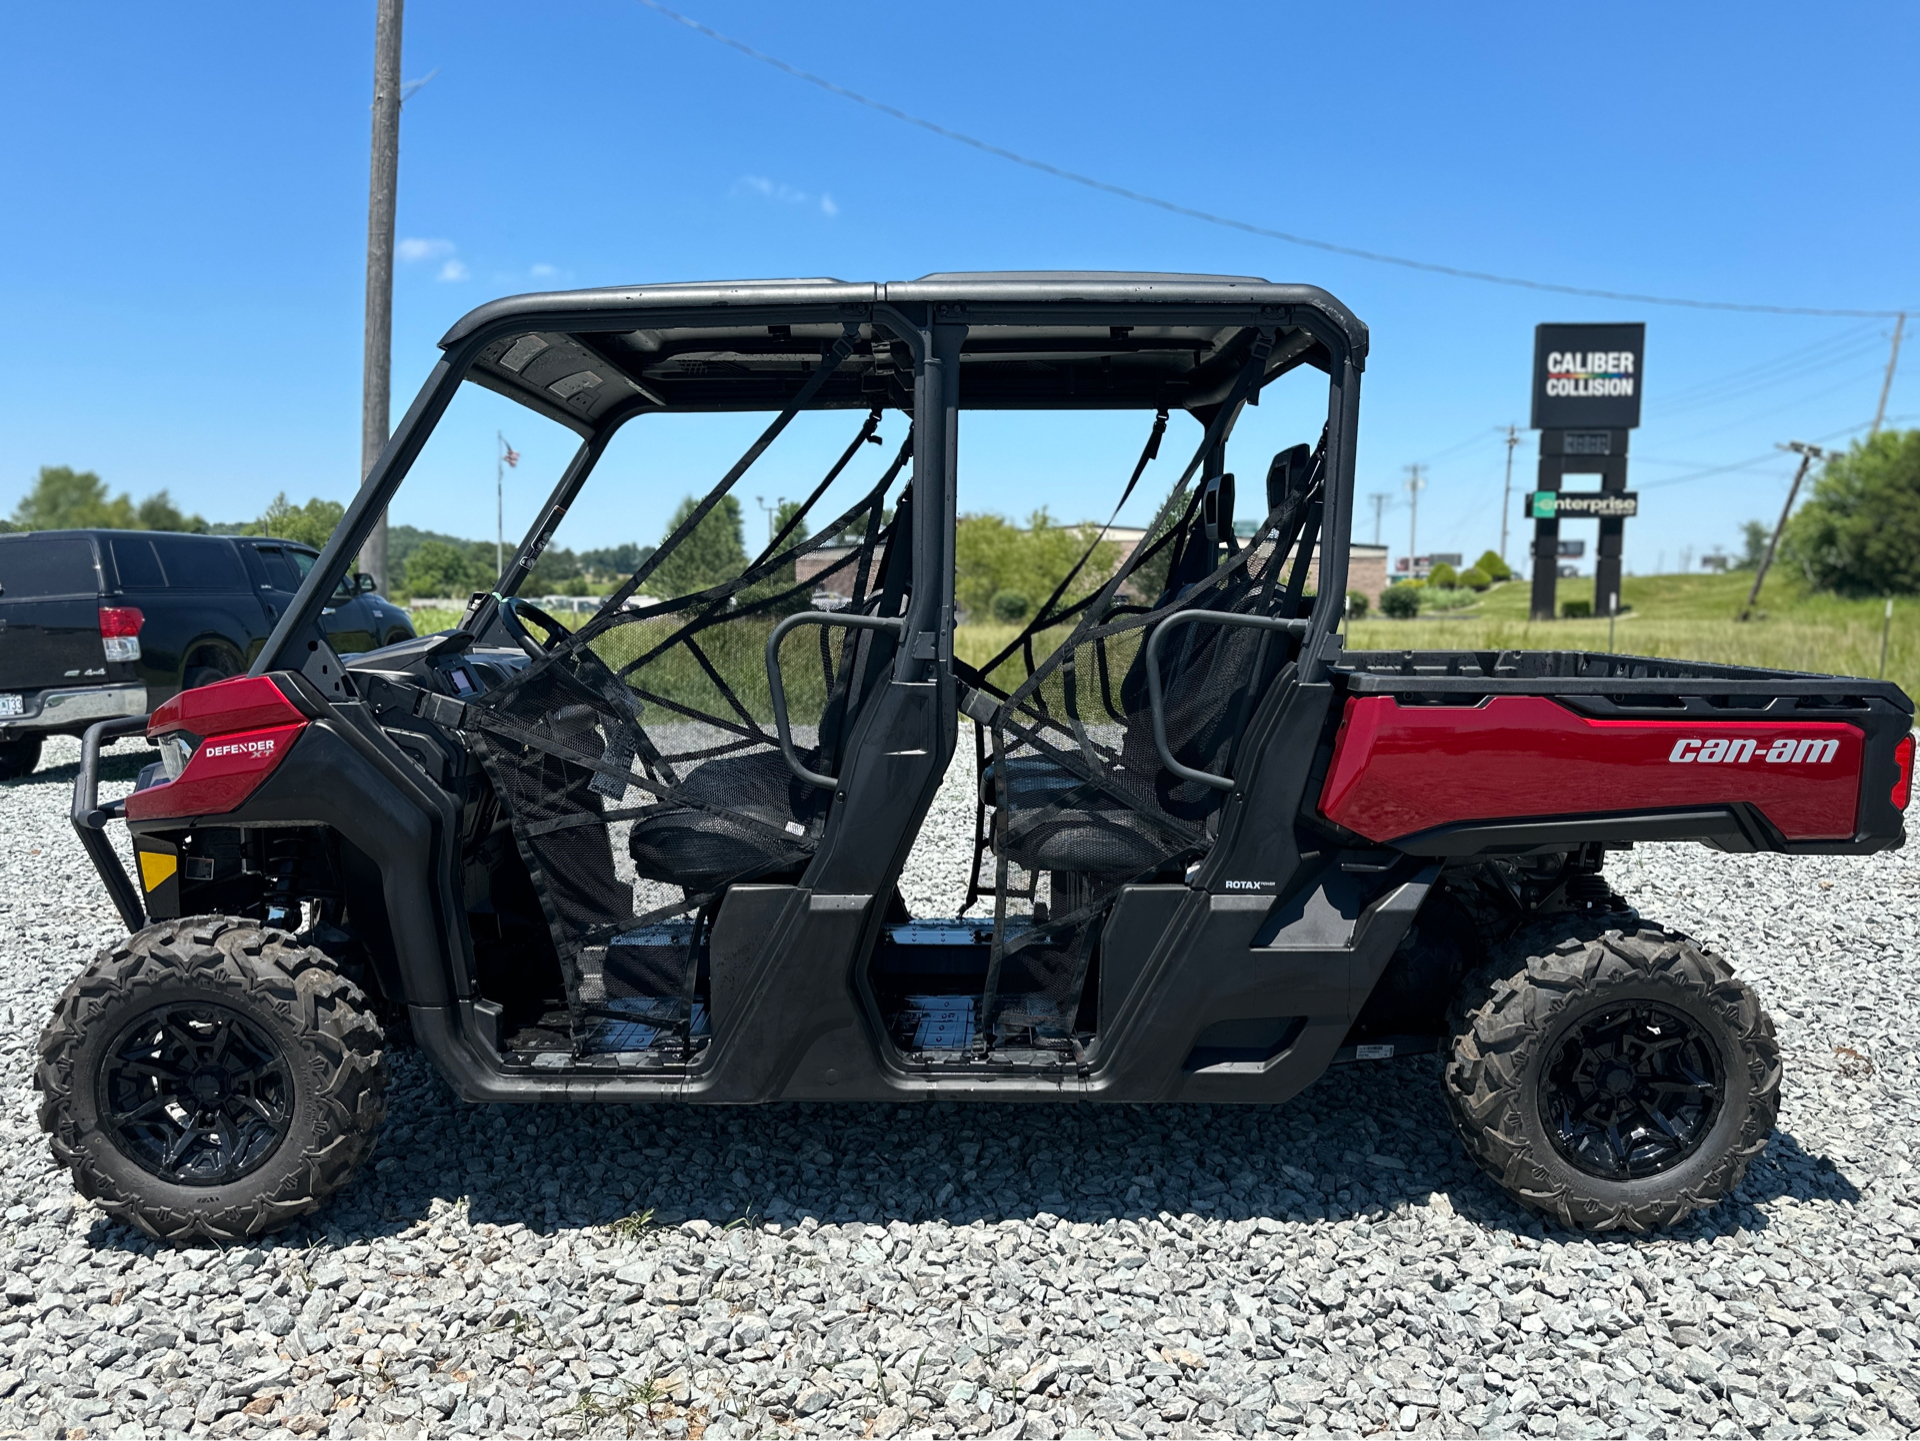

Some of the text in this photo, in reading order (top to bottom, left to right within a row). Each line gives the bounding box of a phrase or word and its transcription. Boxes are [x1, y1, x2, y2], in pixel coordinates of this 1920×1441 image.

[1547, 351, 1635, 374] CALIBER
[1546, 377, 1634, 397] COLLISION
[1535, 495, 1637, 514] enterprise
[206, 739, 275, 758] DEFENDER
[249, 749, 274, 759] XT
[1668, 739, 1840, 763] can-am
[1225, 880, 1261, 890] ROTAX
